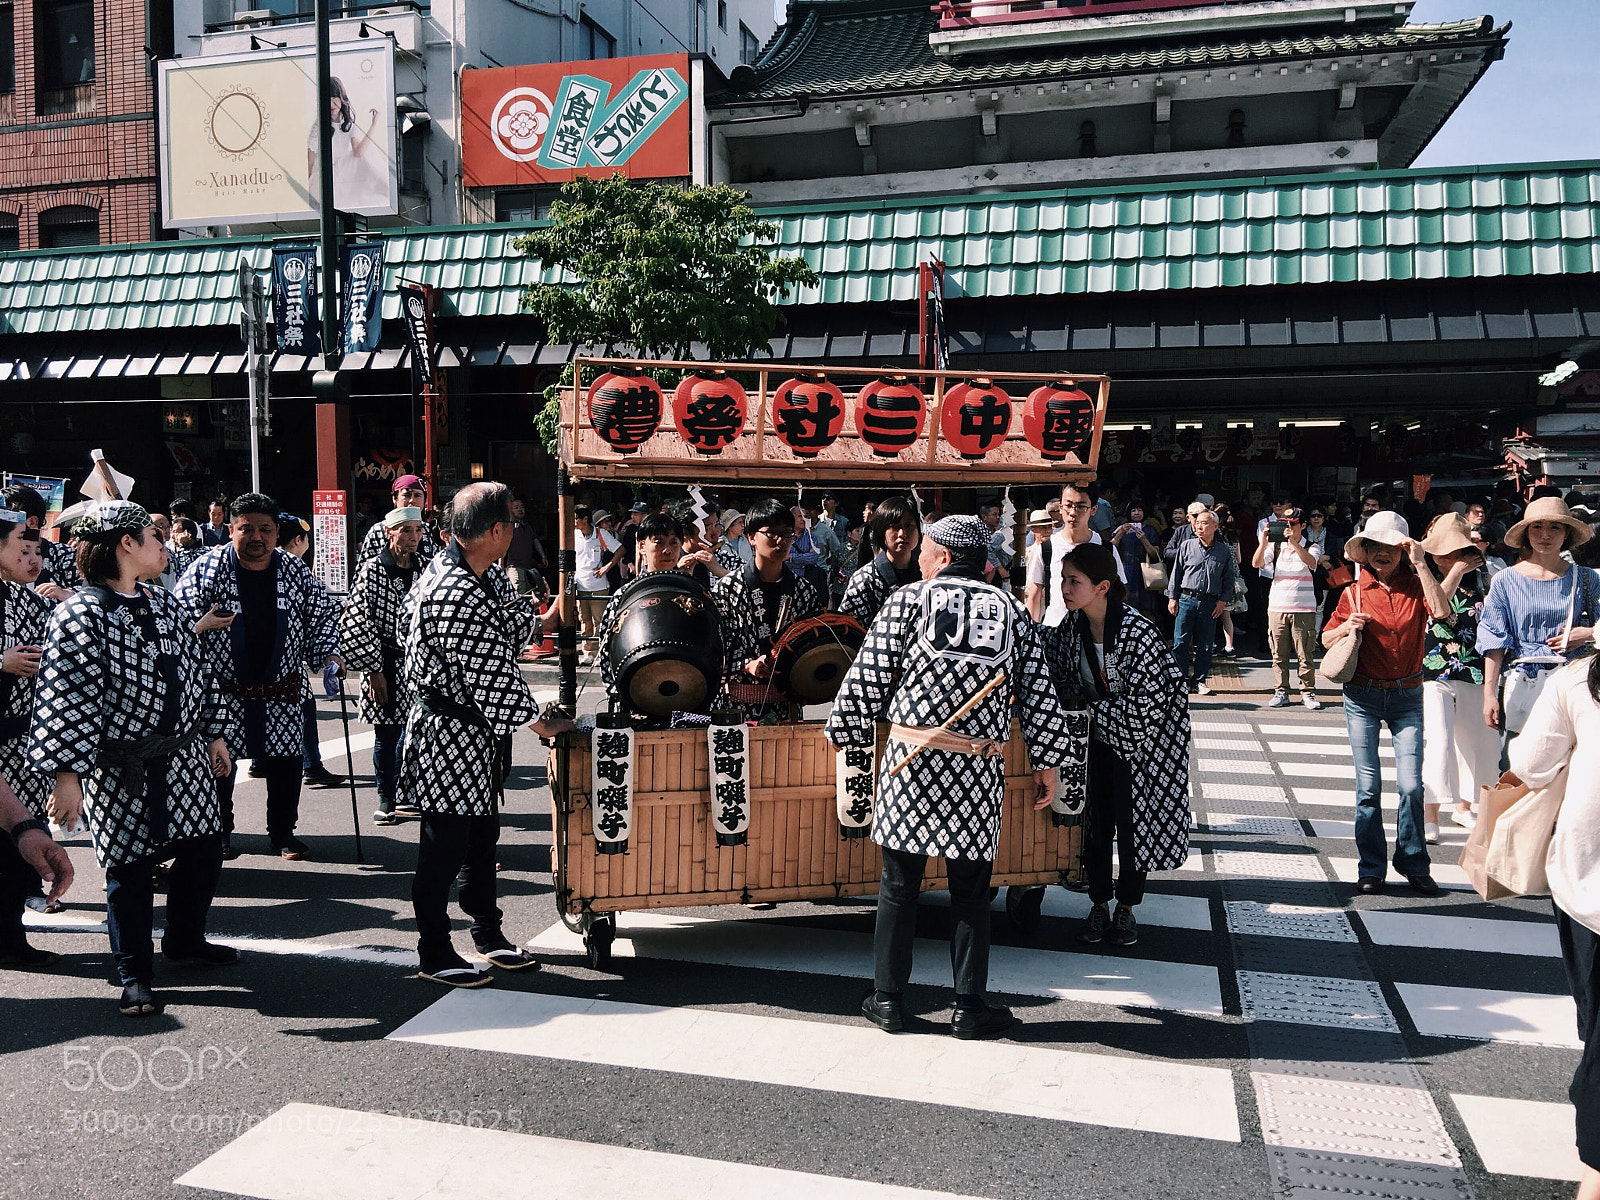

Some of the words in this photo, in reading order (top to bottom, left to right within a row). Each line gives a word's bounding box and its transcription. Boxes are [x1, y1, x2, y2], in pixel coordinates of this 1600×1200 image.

[551, 89, 595, 160] 食堂
[594, 75, 669, 158] ときわ
[209, 168, 269, 188] Xanadu
[284, 283, 304, 348] 三社祭
